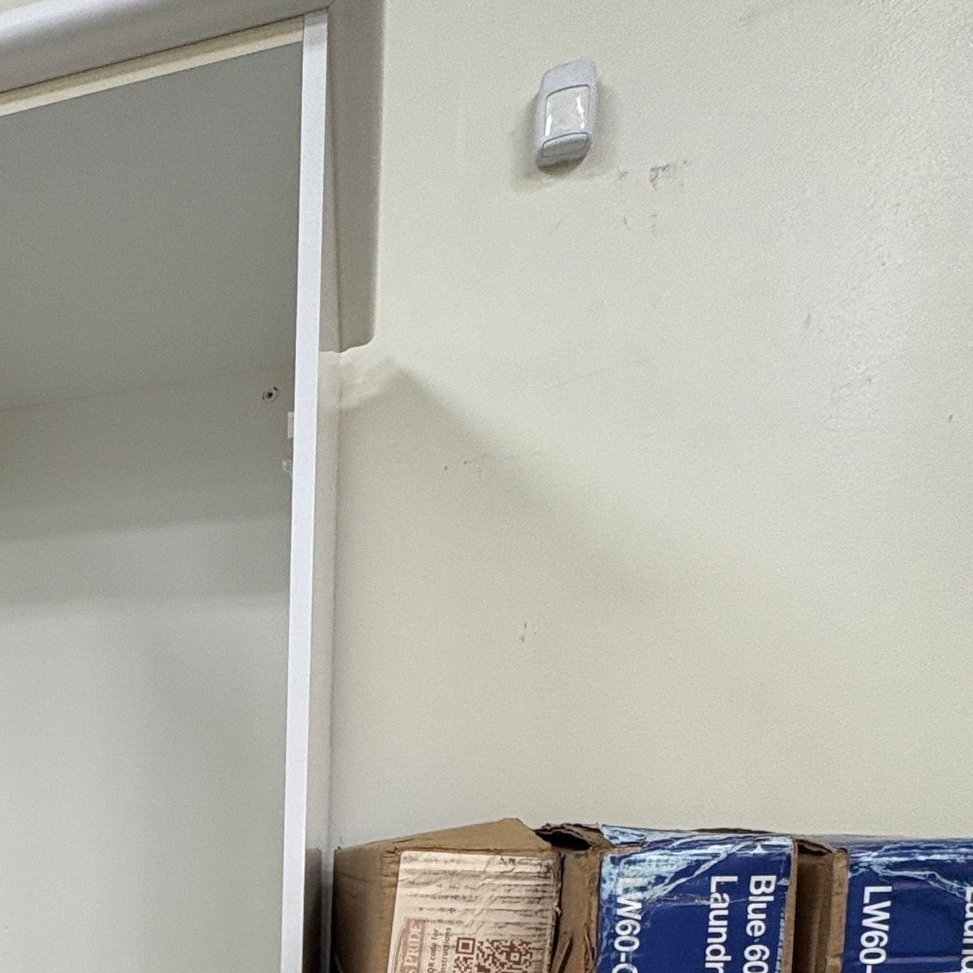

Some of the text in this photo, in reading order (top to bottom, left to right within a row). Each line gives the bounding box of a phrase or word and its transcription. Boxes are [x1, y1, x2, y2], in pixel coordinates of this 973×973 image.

[745, 874, 777, 938] Blue
[430, 928, 439, 941] for
[403, 924, 422, 968] PRIDE
[428, 943, 437, 961] code
[427, 962, 436, 973] QR
